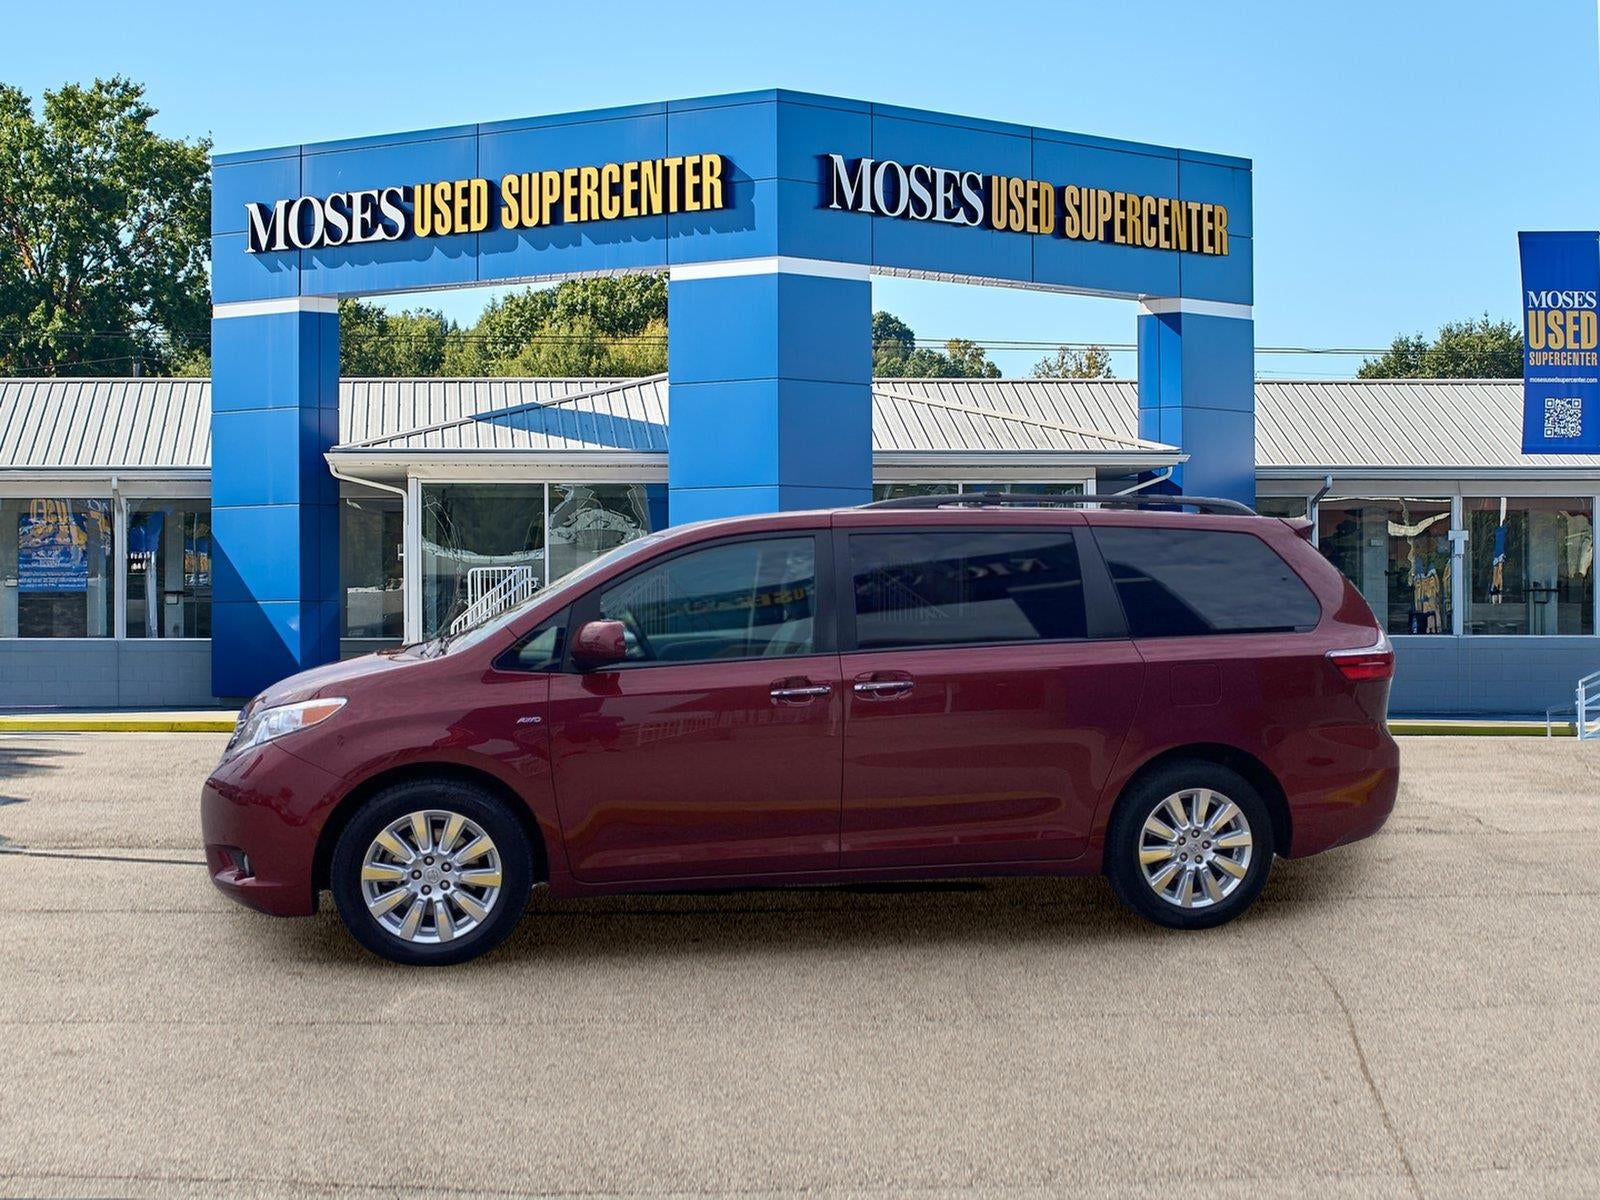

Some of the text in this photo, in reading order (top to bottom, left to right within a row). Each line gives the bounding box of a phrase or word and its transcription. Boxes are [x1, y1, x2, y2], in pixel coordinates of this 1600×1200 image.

[244, 153, 724, 254] MOSES USED SUPERCENTER
[828, 153, 1229, 256] MOSES USED SUPERCENTER
[1527, 290, 1597, 309] MOSES
[1528, 310, 1598, 350] USED
[1529, 351, 1598, 366] SUPERCENTER
